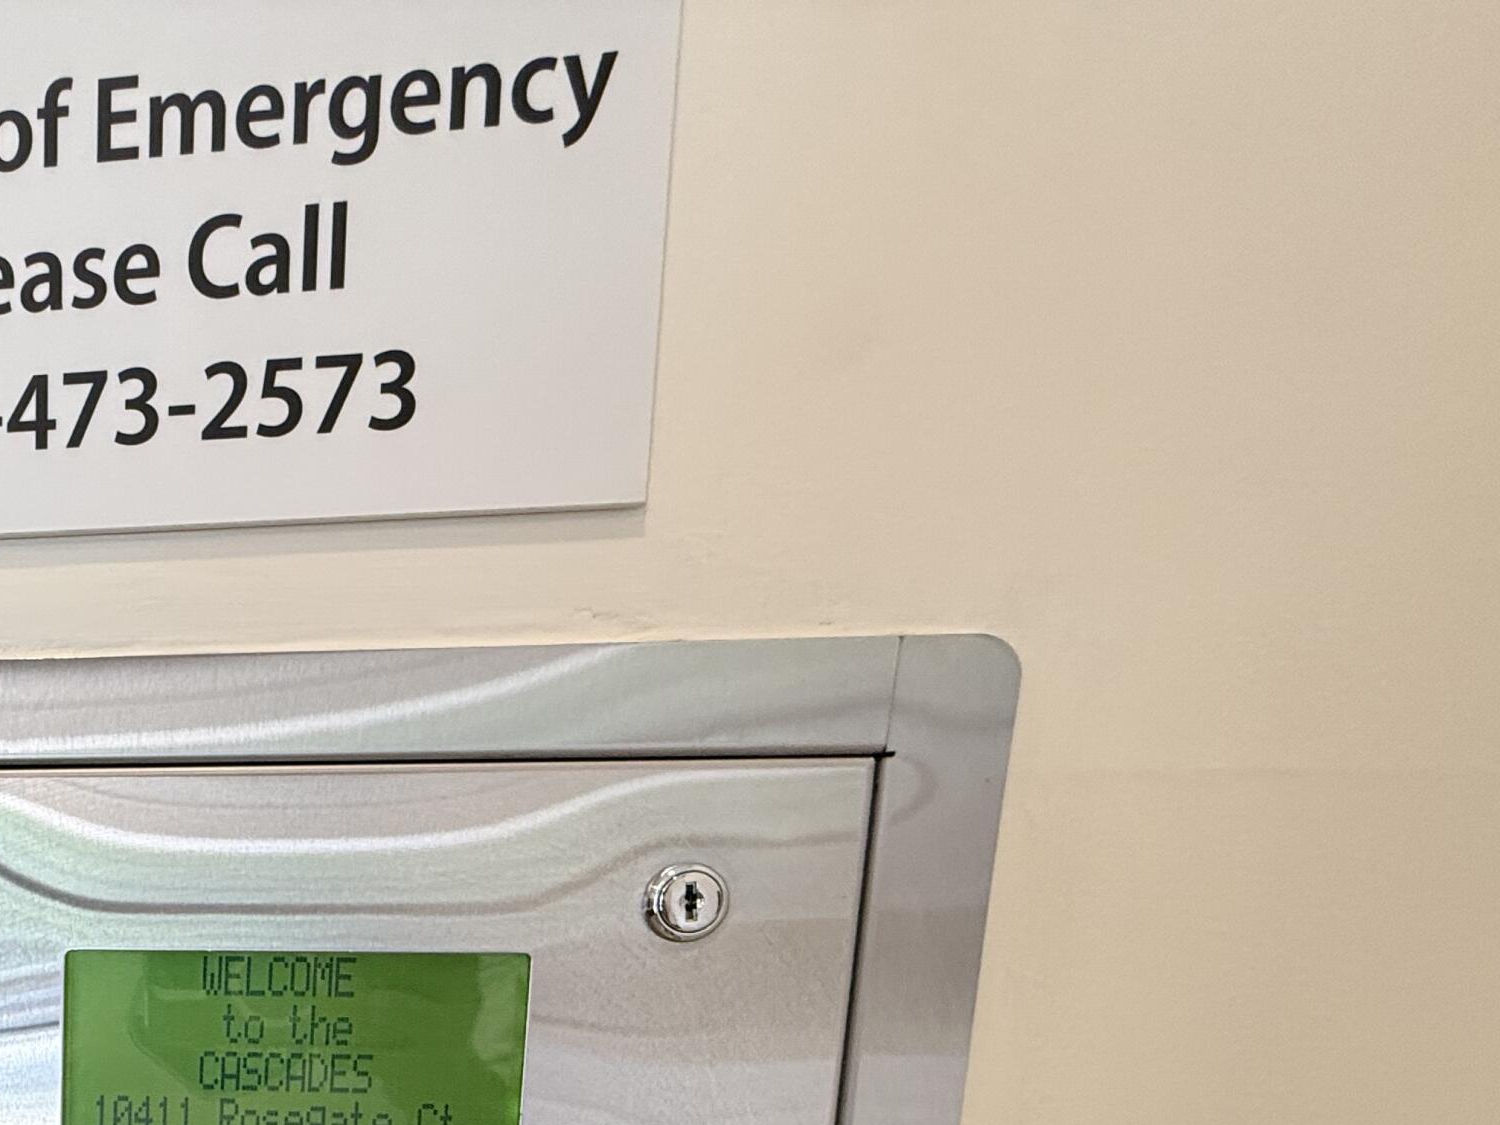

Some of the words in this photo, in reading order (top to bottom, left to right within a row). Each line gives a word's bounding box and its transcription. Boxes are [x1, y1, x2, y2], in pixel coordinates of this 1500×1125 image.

[96, 49, 619, 165] Emergency
[187, 200, 349, 301] Call
[201, 955, 357, 998] WELCOME
[223, 1003, 264, 1045] to
[289, 1004, 353, 1046] the
[199, 1051, 373, 1094] CASCADES
